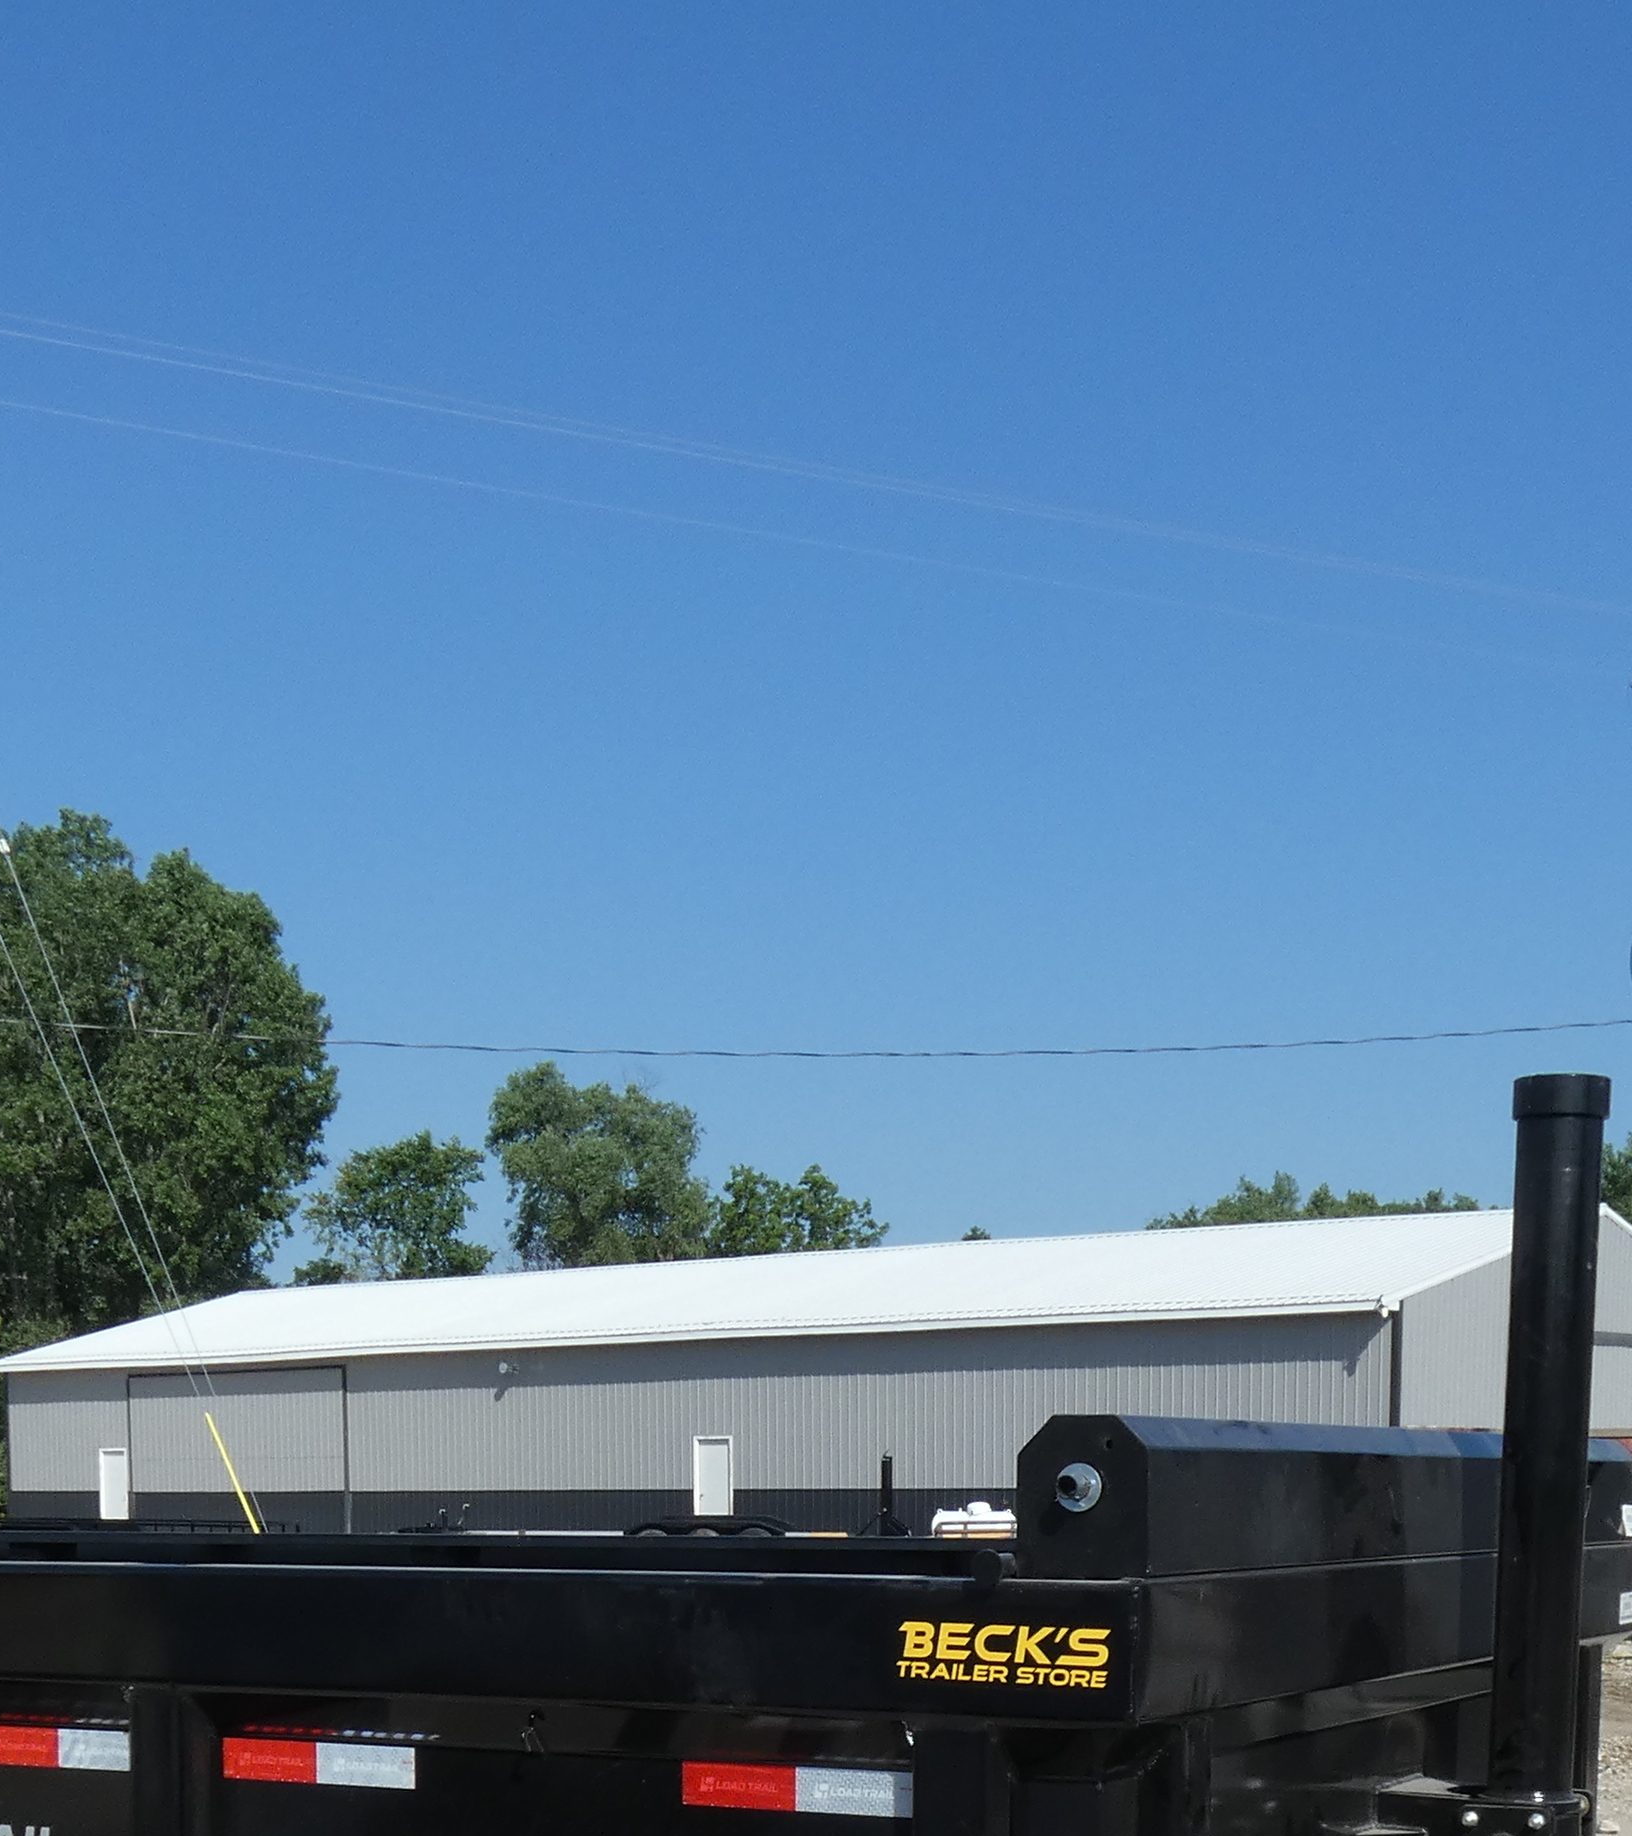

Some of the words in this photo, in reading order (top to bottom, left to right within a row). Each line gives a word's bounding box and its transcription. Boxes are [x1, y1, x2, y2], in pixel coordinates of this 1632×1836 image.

[898, 1620, 1111, 1667] BECK'S
[896, 1660, 1009, 1684] TRAILER
[1015, 1666, 1109, 1689] STORE
